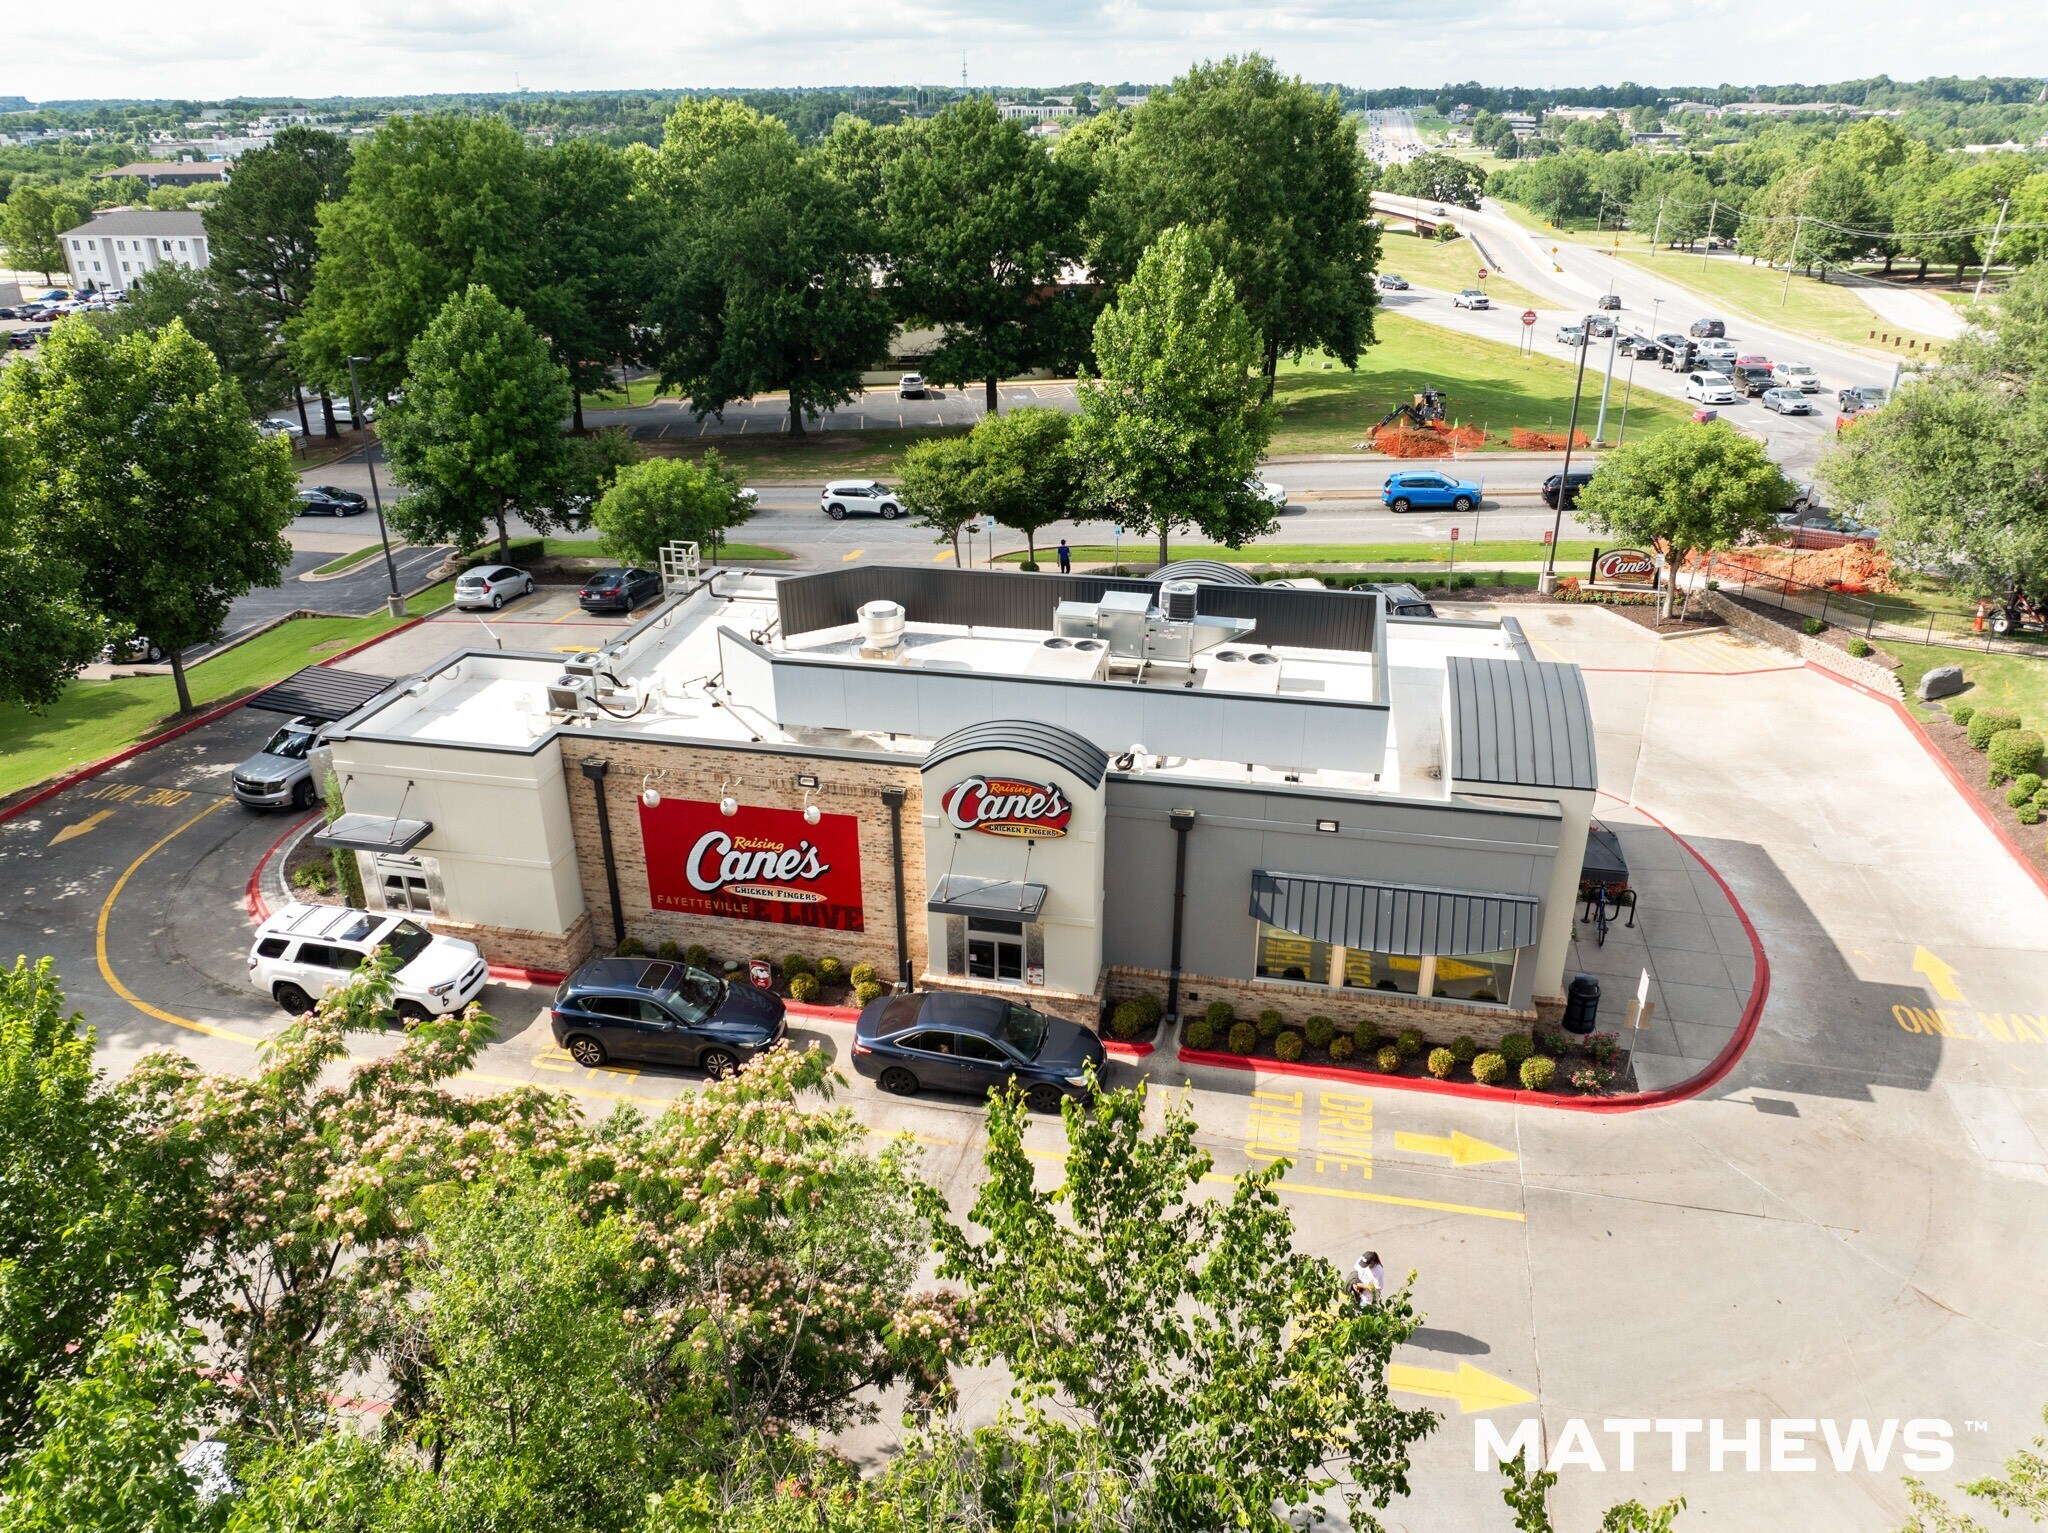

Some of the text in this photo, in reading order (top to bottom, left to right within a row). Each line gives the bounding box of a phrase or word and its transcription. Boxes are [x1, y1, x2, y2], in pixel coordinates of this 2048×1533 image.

[1603, 556, 1653, 578] Cane's
[990, 783, 1033, 796] Raising
[948, 779, 1069, 829] Cane's
[989, 825, 1058, 837] CHICKEN FINGERS
[733, 836, 784, 853] Raising
[686, 831, 830, 891] Cane's
[657, 894, 749, 913] FAYETTEVILLE
[735, 885, 817, 901] CHICKEN FINGERS
[782, 901, 864, 931] LOVE
[1892, 1004, 1974, 1040] ONE
[1244, 1091, 1303, 1165] THRU
[1315, 1091, 1373, 1180] DRIVE
